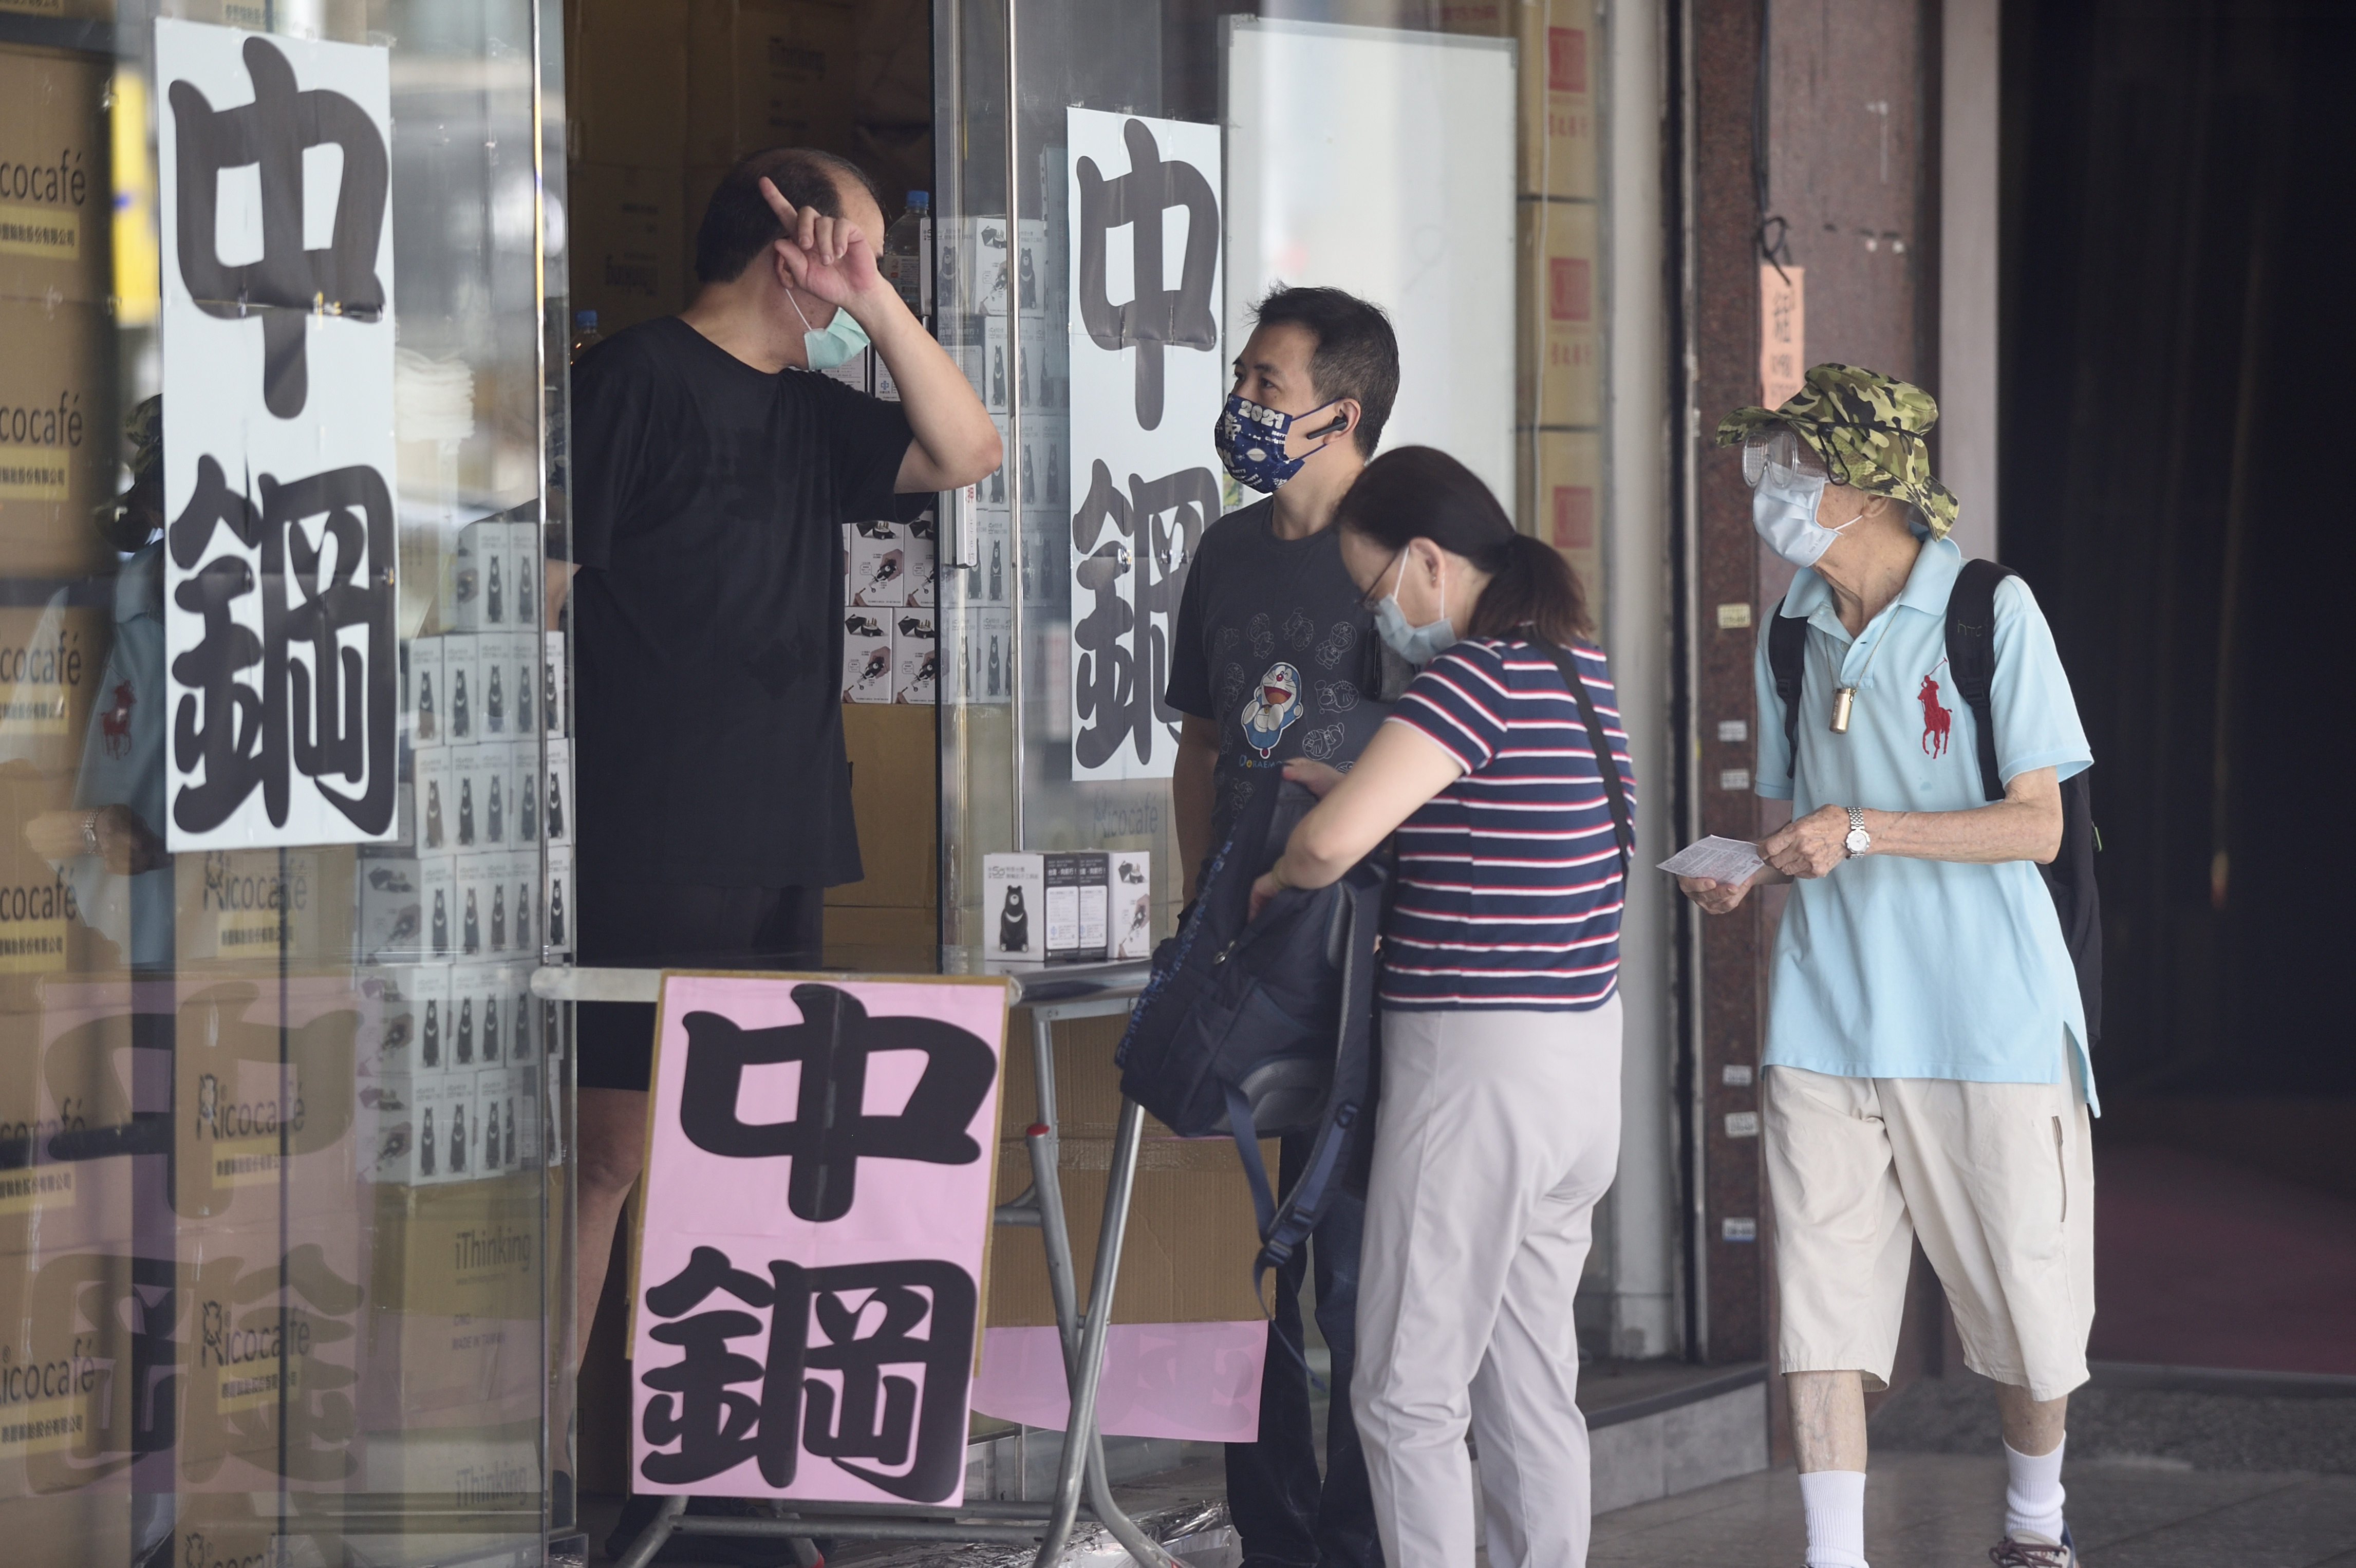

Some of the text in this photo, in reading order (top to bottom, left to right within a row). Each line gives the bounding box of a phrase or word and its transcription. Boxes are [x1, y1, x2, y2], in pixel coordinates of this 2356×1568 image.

[169, 36, 396, 836] 中鋼
[1072, 118, 1223, 770] 中鋼
[1238, 400, 1285, 430] 2021
[0, 866, 77, 921] cocafé
[455, 1225, 531, 1272] iThinking
[640, 982, 998, 1503] 中鋼
[0, 1338, 95, 1405] icocafé
